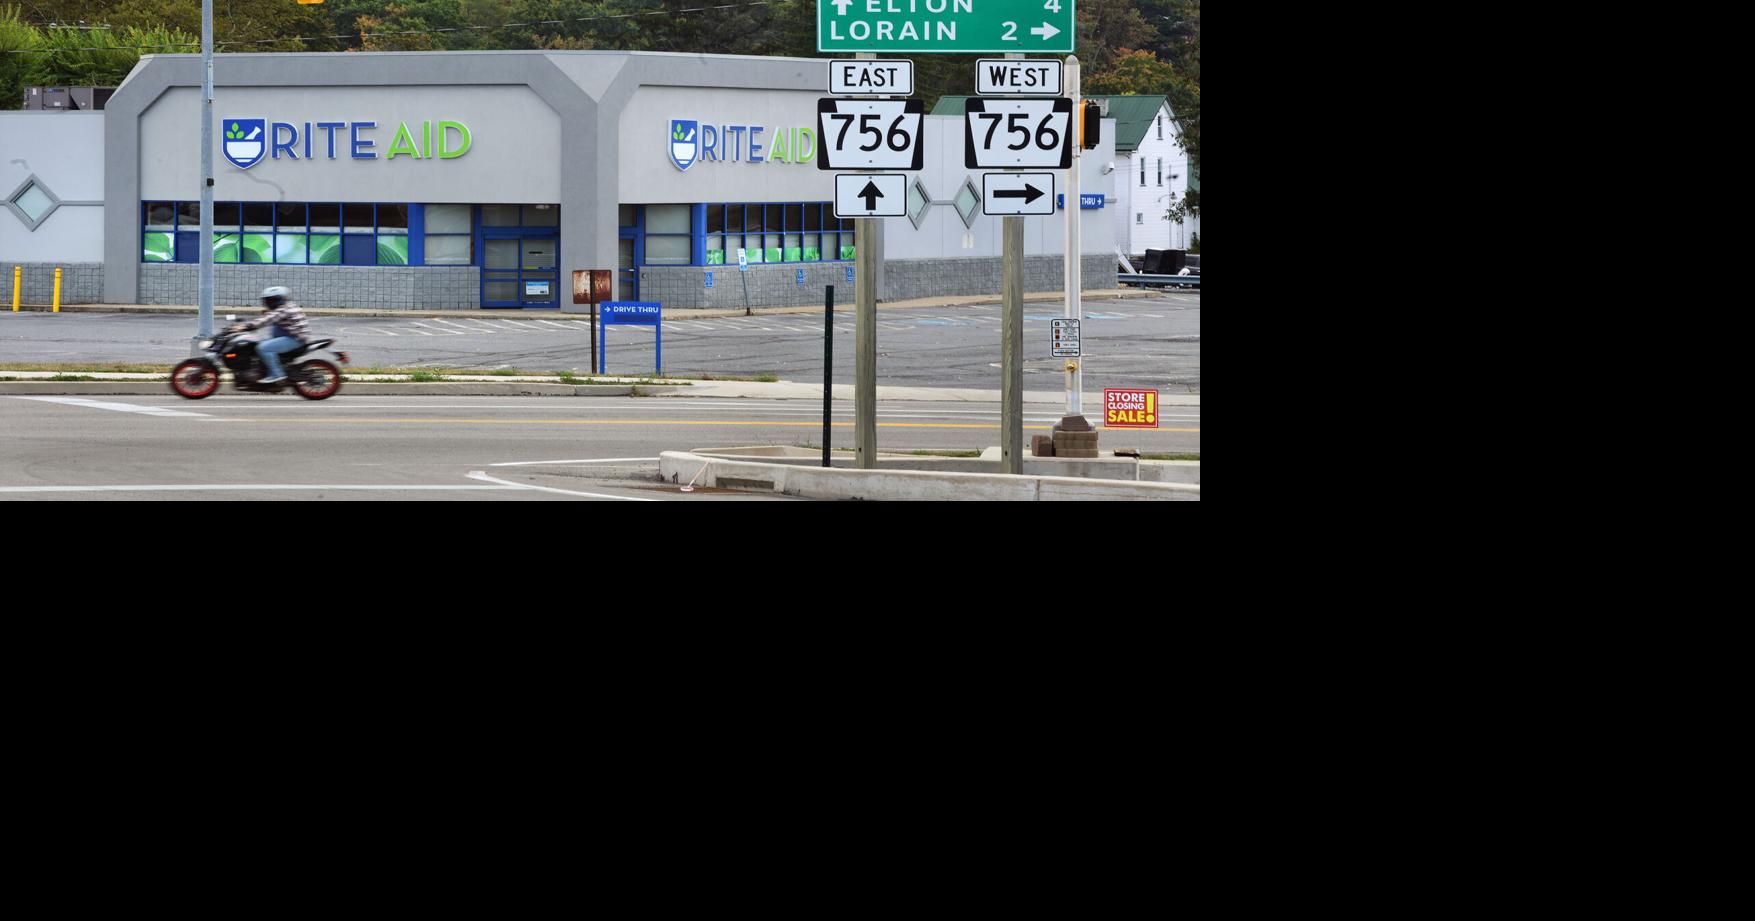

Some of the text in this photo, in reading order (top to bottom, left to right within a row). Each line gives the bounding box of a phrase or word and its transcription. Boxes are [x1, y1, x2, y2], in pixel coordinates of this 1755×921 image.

[866, 0, 1062, 13] ELTON 4
[830, 20, 1018, 41] LORAIN 2
[843, 66, 898, 87] EAST
[989, 65, 1049, 87] WEST
[271, 120, 472, 159] RITE AID
[830, 114, 911, 152] 756
[978, 113, 1060, 151] 756
[699, 124, 817, 163] RITE AID
[1081, 197, 1096, 205] THRU
[638, 306, 659, 314] THRU
[1108, 392, 1145, 402] STORE
